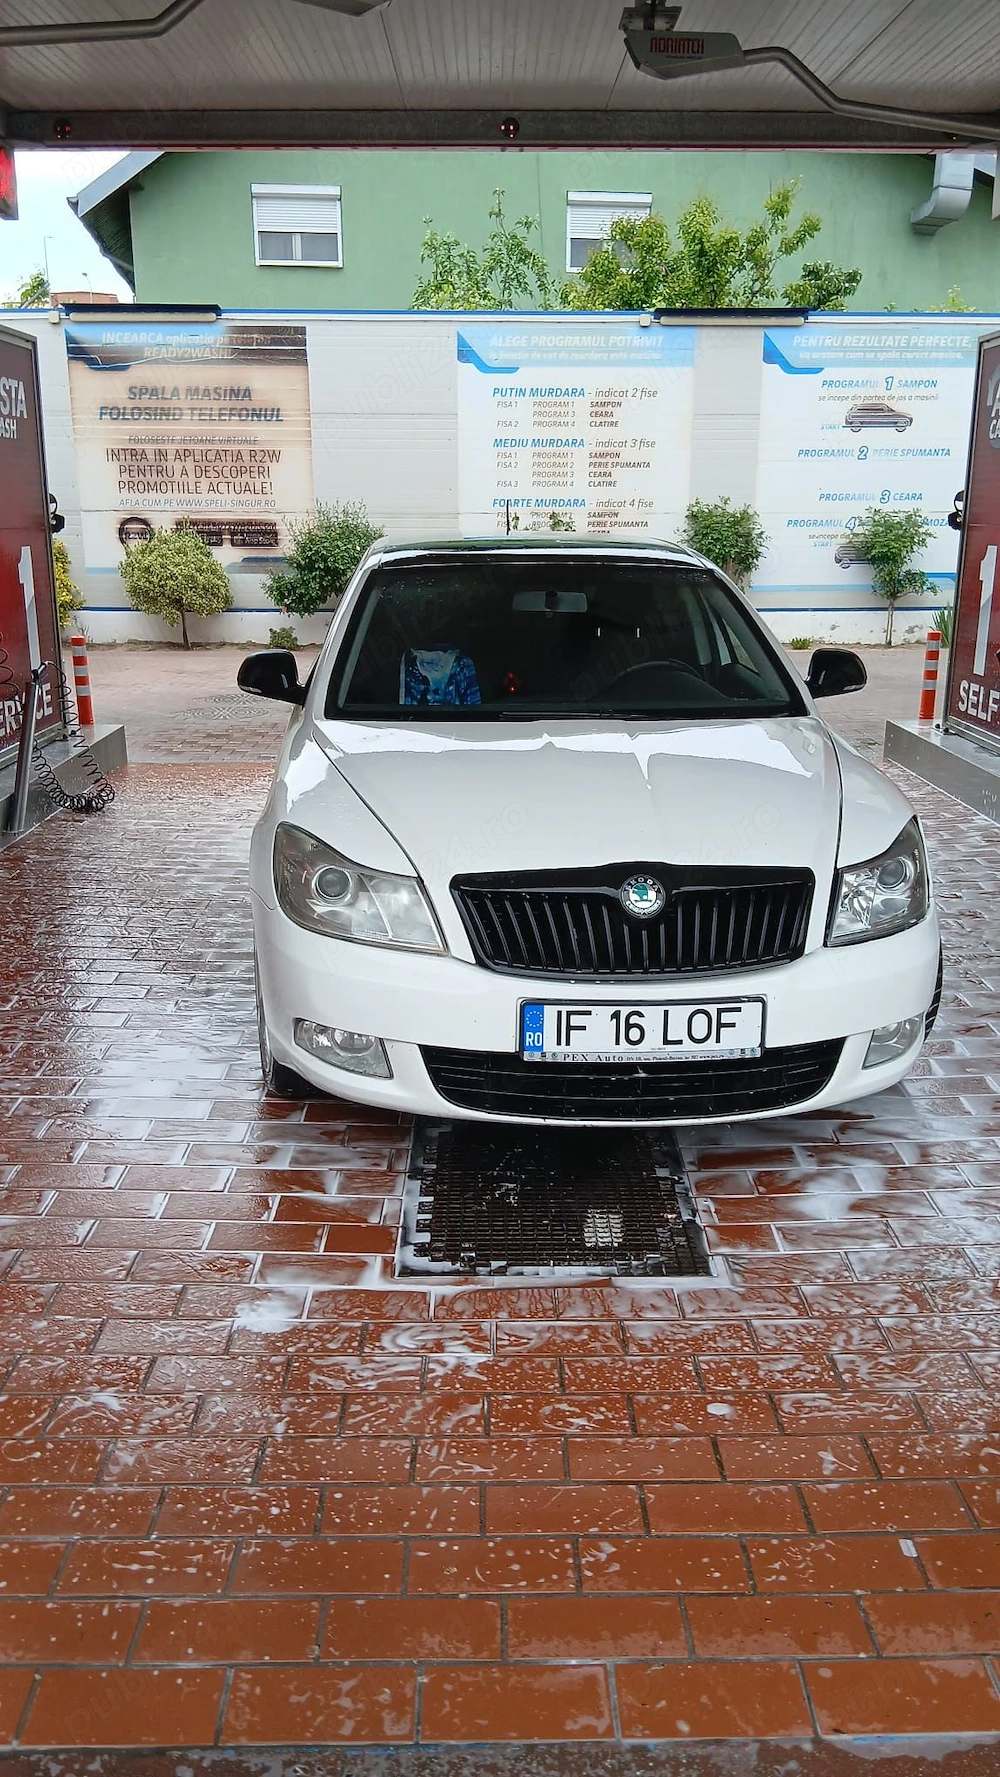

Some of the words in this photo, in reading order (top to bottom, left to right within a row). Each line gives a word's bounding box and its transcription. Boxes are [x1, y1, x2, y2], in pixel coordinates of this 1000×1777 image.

[102, 332, 164, 343] INCEARCA
[490, 335, 528, 347] ALEGE
[530, 335, 606, 347] PROGRAMUL
[608, 335, 664, 347] POTRIVIT
[793, 336, 842, 347] PENTRU
[843, 336, 908, 347] REZULTATE
[821, 379, 880, 388] PROGRAMUL
[884, 376, 894, 390] 1
[897, 379, 938, 388] SAMPON
[127, 385, 180, 400] SPALA
[185, 385, 253, 401] MASINA
[492, 388, 526, 398] PUTIN
[529, 388, 585, 398] MURDARA
[595, 388, 628, 398] indicat
[631, 388, 638, 398] 2
[638, 387, 658, 400] fise
[828, 394, 850, 402] incepe
[99, 406, 182, 422] FOLOSIND
[189, 406, 284, 422] TELEFONUL
[532, 410, 570, 418] PROGRAM
[590, 410, 614, 418] CEARA
[497, 420, 513, 428] FISA
[532, 420, 570, 428] PROGRAM
[589, 420, 620, 428] CLATIRE
[128, 436, 176, 445] FOLOSESTE
[179, 436, 218, 445] JETOANE
[218, 436, 259, 445] VIRTUALE
[492, 438, 529, 448] MEDIU
[530, 438, 585, 448] MURDARA
[595, 438, 628, 448] indicat
[630, 438, 638, 448] 3
[638, 438, 656, 450] fise
[106, 448, 149, 463] INTRA
[154, 448, 168, 463] IN
[174, 449, 246, 464] APLICATIA
[250, 449, 282, 464] R2W
[798, 448, 856, 458] PROGRAMUL
[857, 446, 869, 460] 2
[873, 448, 898, 457] PERIE
[900, 448, 951, 457] SPUMANTA
[119, 465, 175, 478] PENTRU
[180, 466, 190, 478] A
[194, 466, 270, 479] DESCOPERI
[118, 480, 202, 494] PROMOTIILE
[207, 481, 274, 495] ACTUALE!
[497, 480, 513, 488] FISA
[532, 480, 568, 488] PROGRAM
[588, 480, 618, 488] CLATIRE
[119, 498, 141, 508] AFLA
[142, 498, 163, 508] CUM
[164, 498, 174, 508] PE
[176, 498, 276, 508] WWW.SPELI-SINGUR.RO
[818, 493, 875, 502] PROGRAMUL
[880, 490, 891, 504] 3
[893, 492, 923, 501] CEARA
[492, 498, 532, 508] FOARTE
[534, 498, 586, 508] MURDARA
[596, 498, 627, 508] indicat
[628, 498, 635, 508] 4
[636, 498, 654, 510] fise
[786, 518, 844, 528] PROGRAMUL
[844, 516, 857, 531] 4
[18, 546, 41, 671] 1
[973, 545, 998, 676] 1
[958, 679, 1000, 723] SELF
[556, 1010, 592, 1046] IF
[610, 1010, 646, 1046] 16
[662, 1007, 742, 1046] LOF
[525, 1032, 543, 1046] RO
[563, 1054, 589, 1062] PEX
[596, 1053, 624, 1062] Auto
